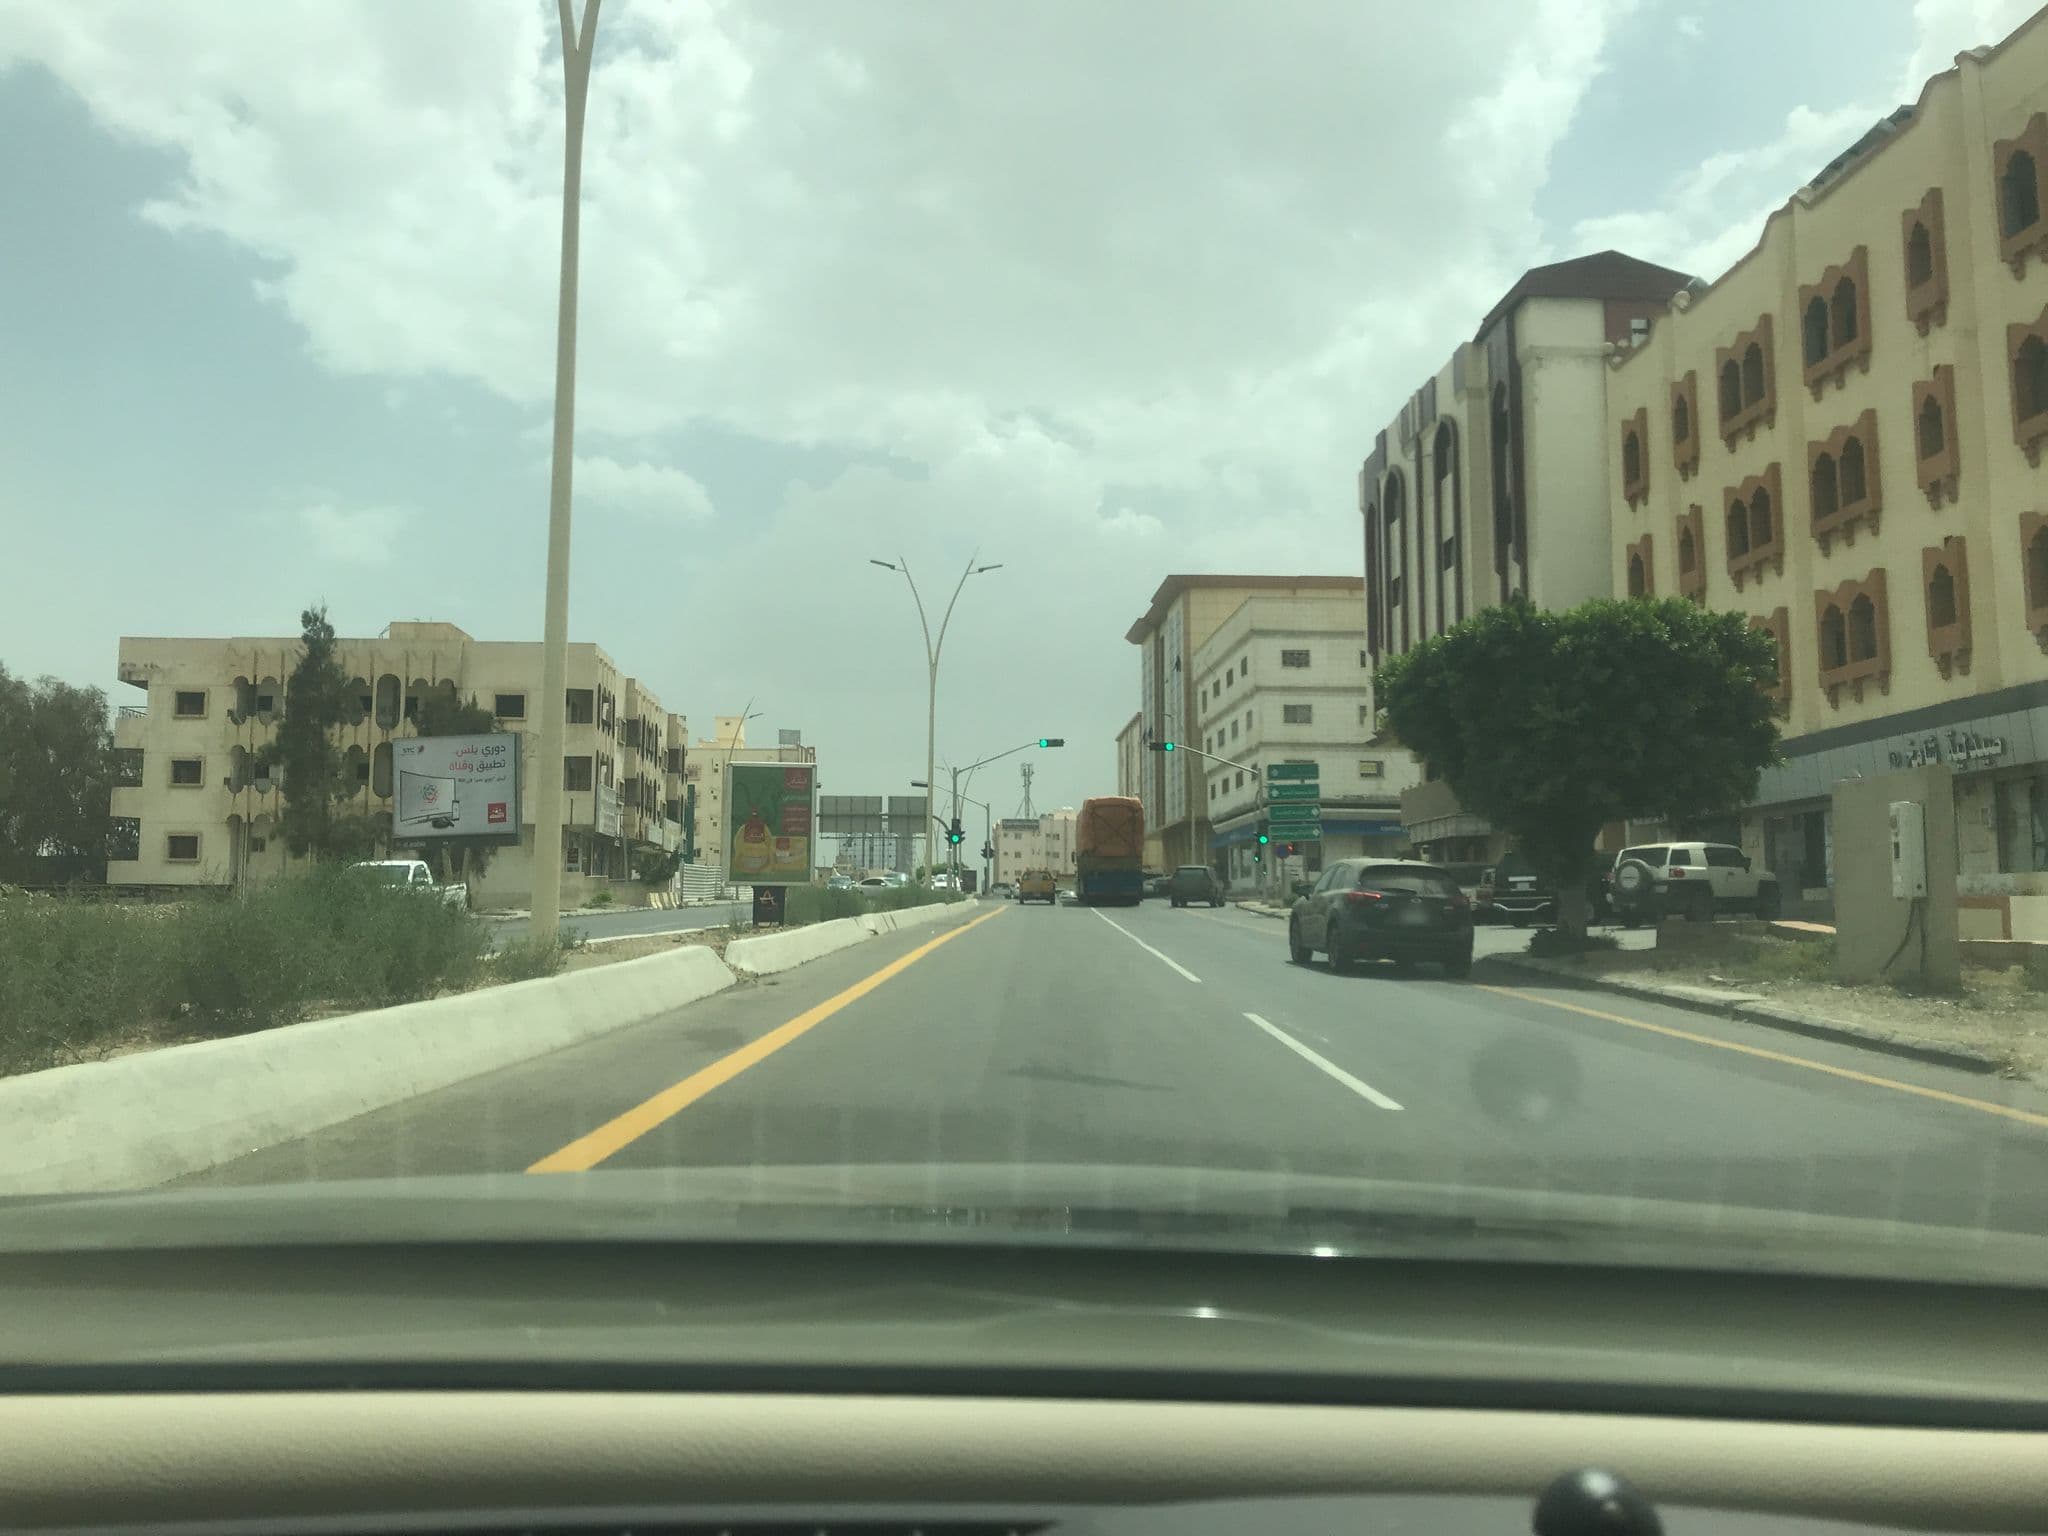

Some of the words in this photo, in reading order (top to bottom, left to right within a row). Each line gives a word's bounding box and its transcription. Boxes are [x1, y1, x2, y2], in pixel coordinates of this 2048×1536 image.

[456, 744, 478, 757] بلس
[481, 744, 506, 757] دوري
[1945, 731, 2003, 769] صيدلية
[476, 759, 506, 773] تطبيق
